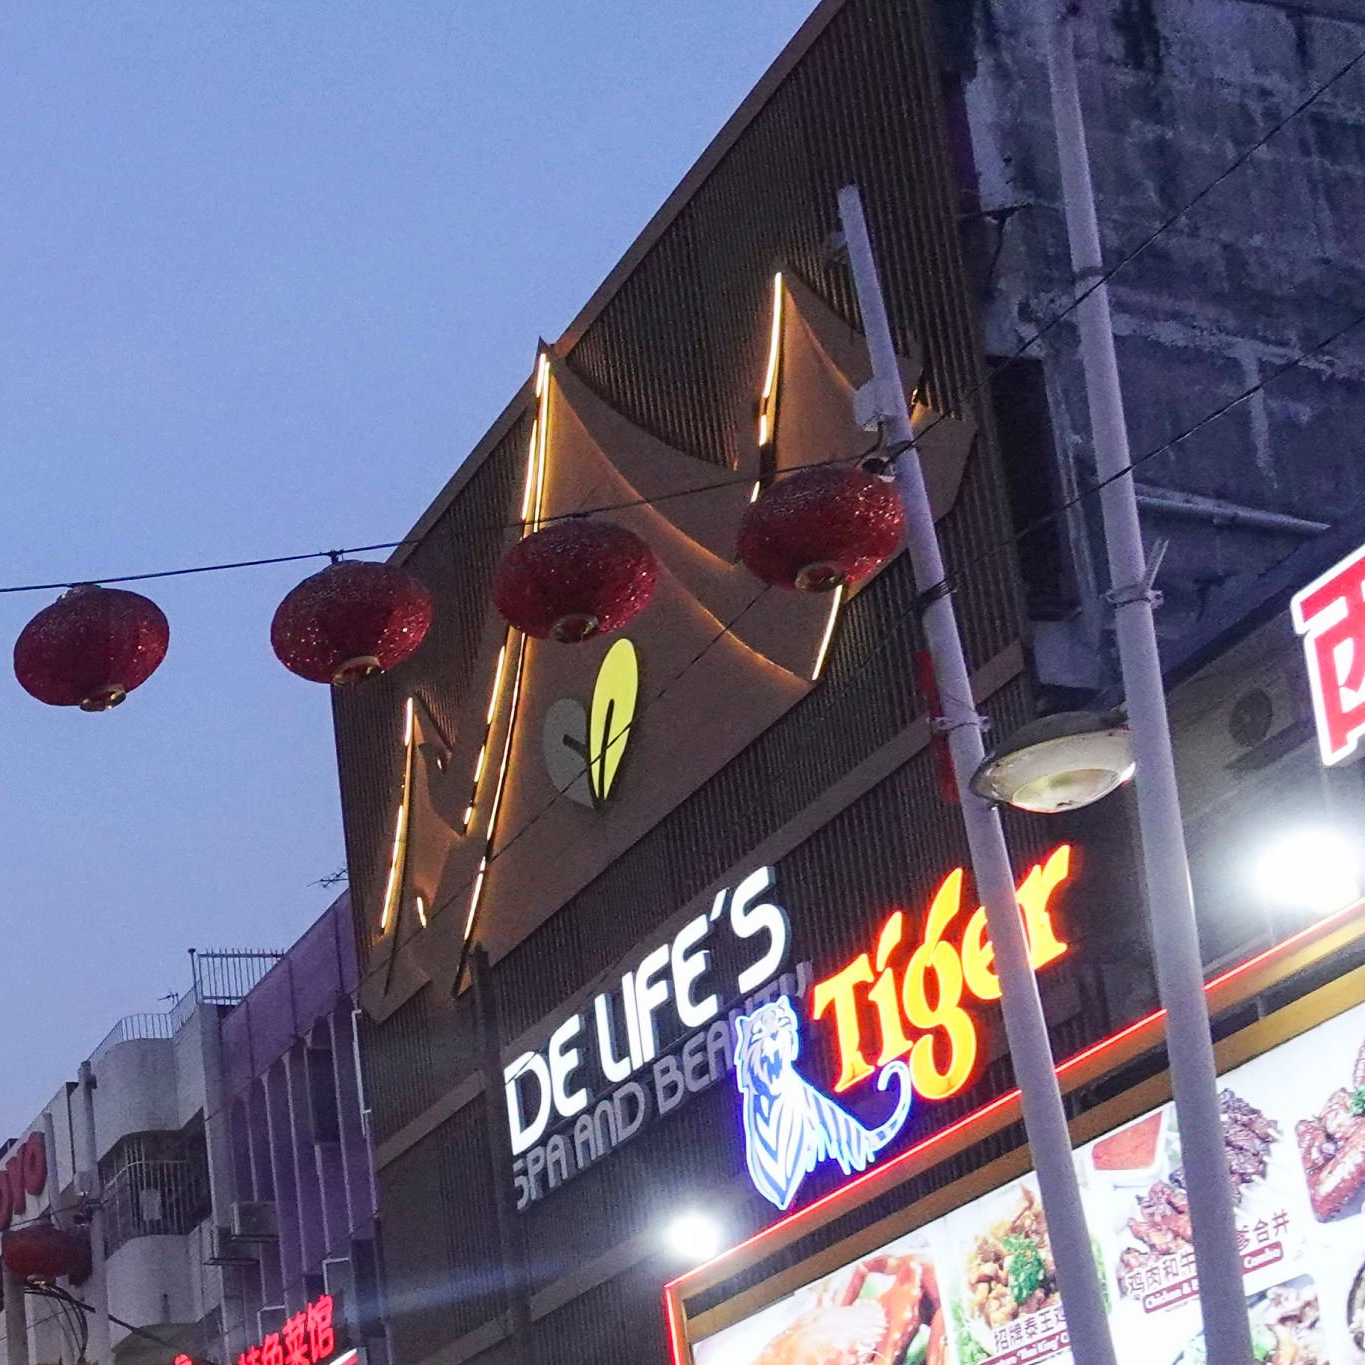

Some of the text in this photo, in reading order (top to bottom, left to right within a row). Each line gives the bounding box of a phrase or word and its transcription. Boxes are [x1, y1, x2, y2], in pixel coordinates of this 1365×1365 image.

[504, 864, 790, 1156] DE LIFE'S
[812, 843, 1071, 1102] Tiger
[514, 1131, 572, 1212] SPA
[575, 1087, 648, 1170] AND
